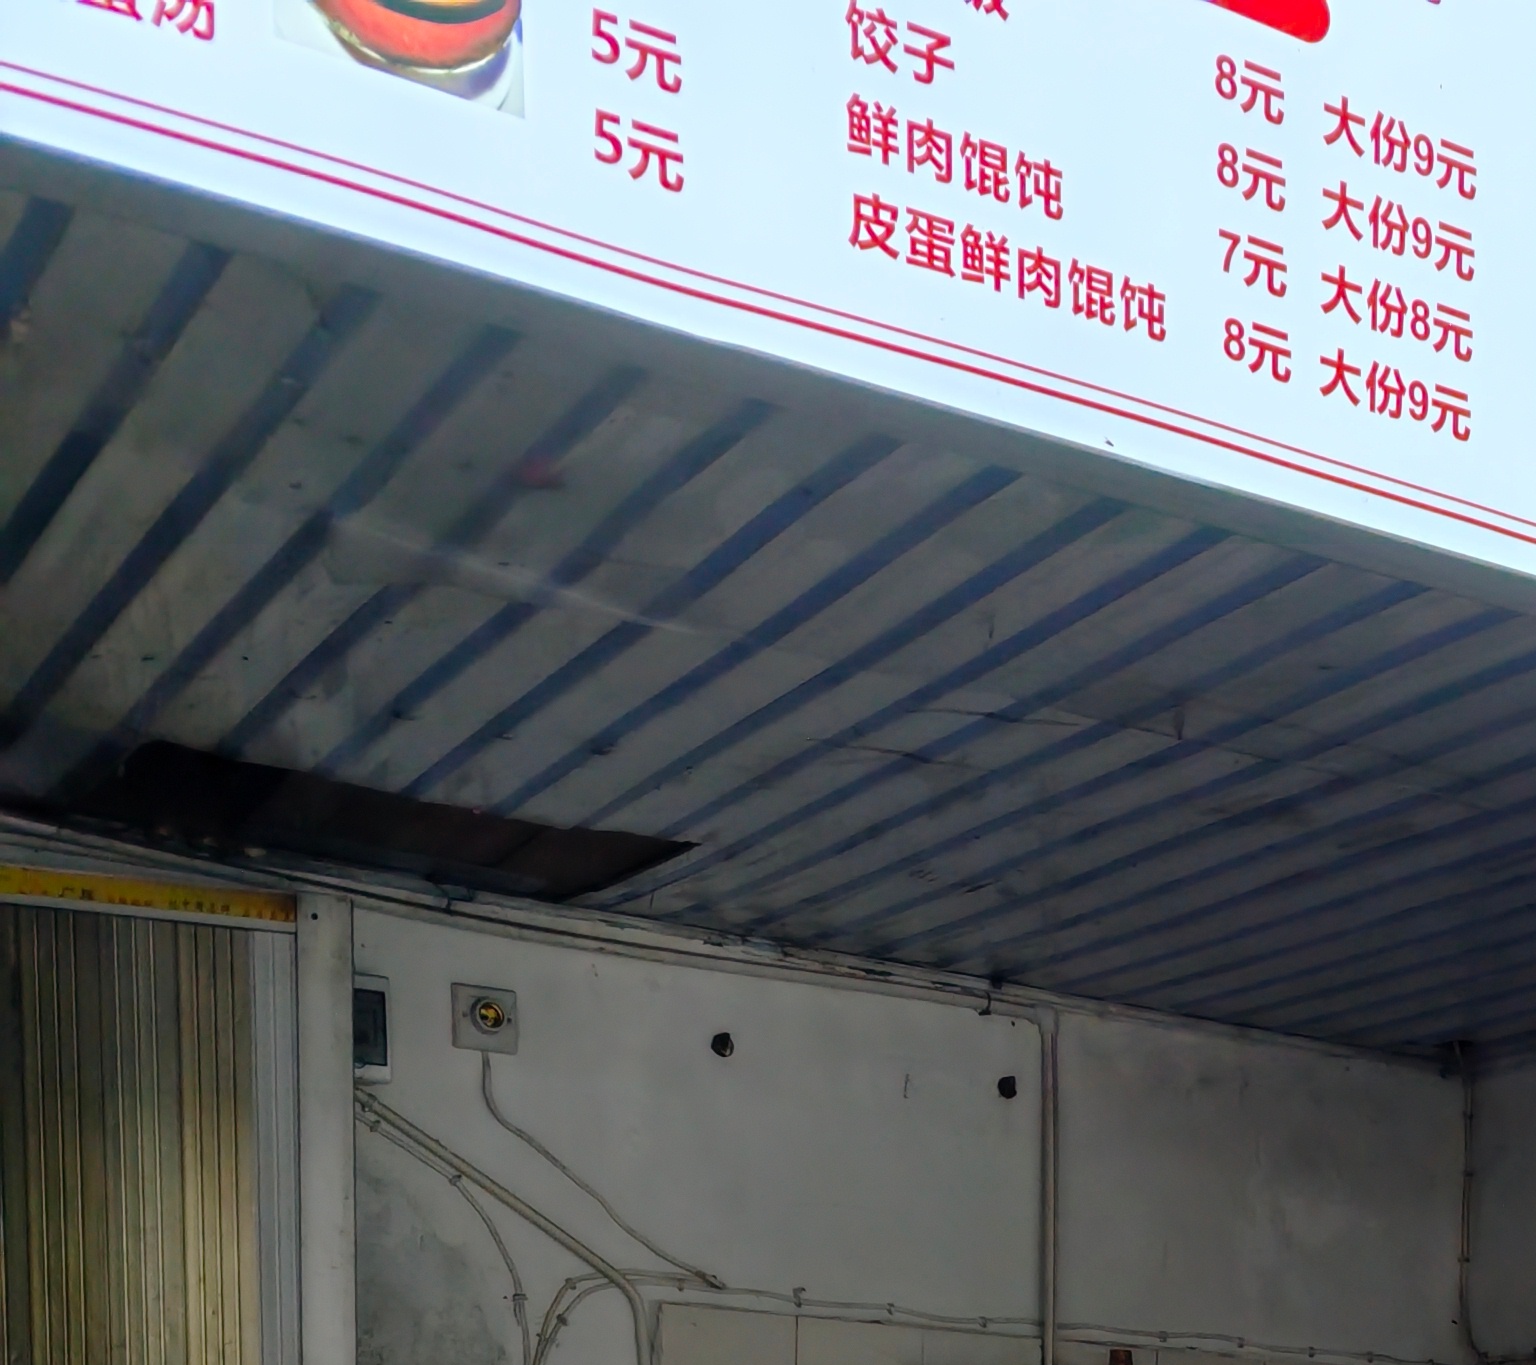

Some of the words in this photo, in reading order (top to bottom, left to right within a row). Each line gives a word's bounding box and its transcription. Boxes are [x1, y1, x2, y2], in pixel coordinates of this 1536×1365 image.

[591, 7, 683, 94] 5元
[845, 0, 955, 84] 饺子
[594, 108, 684, 193] 5元
[846, 93, 1064, 221] 鲜肉馄饨
[1216, 143, 1286, 213] 8元
[1321, 181, 1475, 283] 大份9元
[1215, 54, 1285, 126] 8元
[1323, 96, 1478, 201] 大份9元
[848, 192, 1167, 343] 皮蛋鲜肉馄饨
[1218, 228, 1288, 299] 7元
[1320, 264, 1474, 364] 大份8元
[1223, 317, 1292, 385] 8元
[1319, 348, 1472, 443] 大份9元
